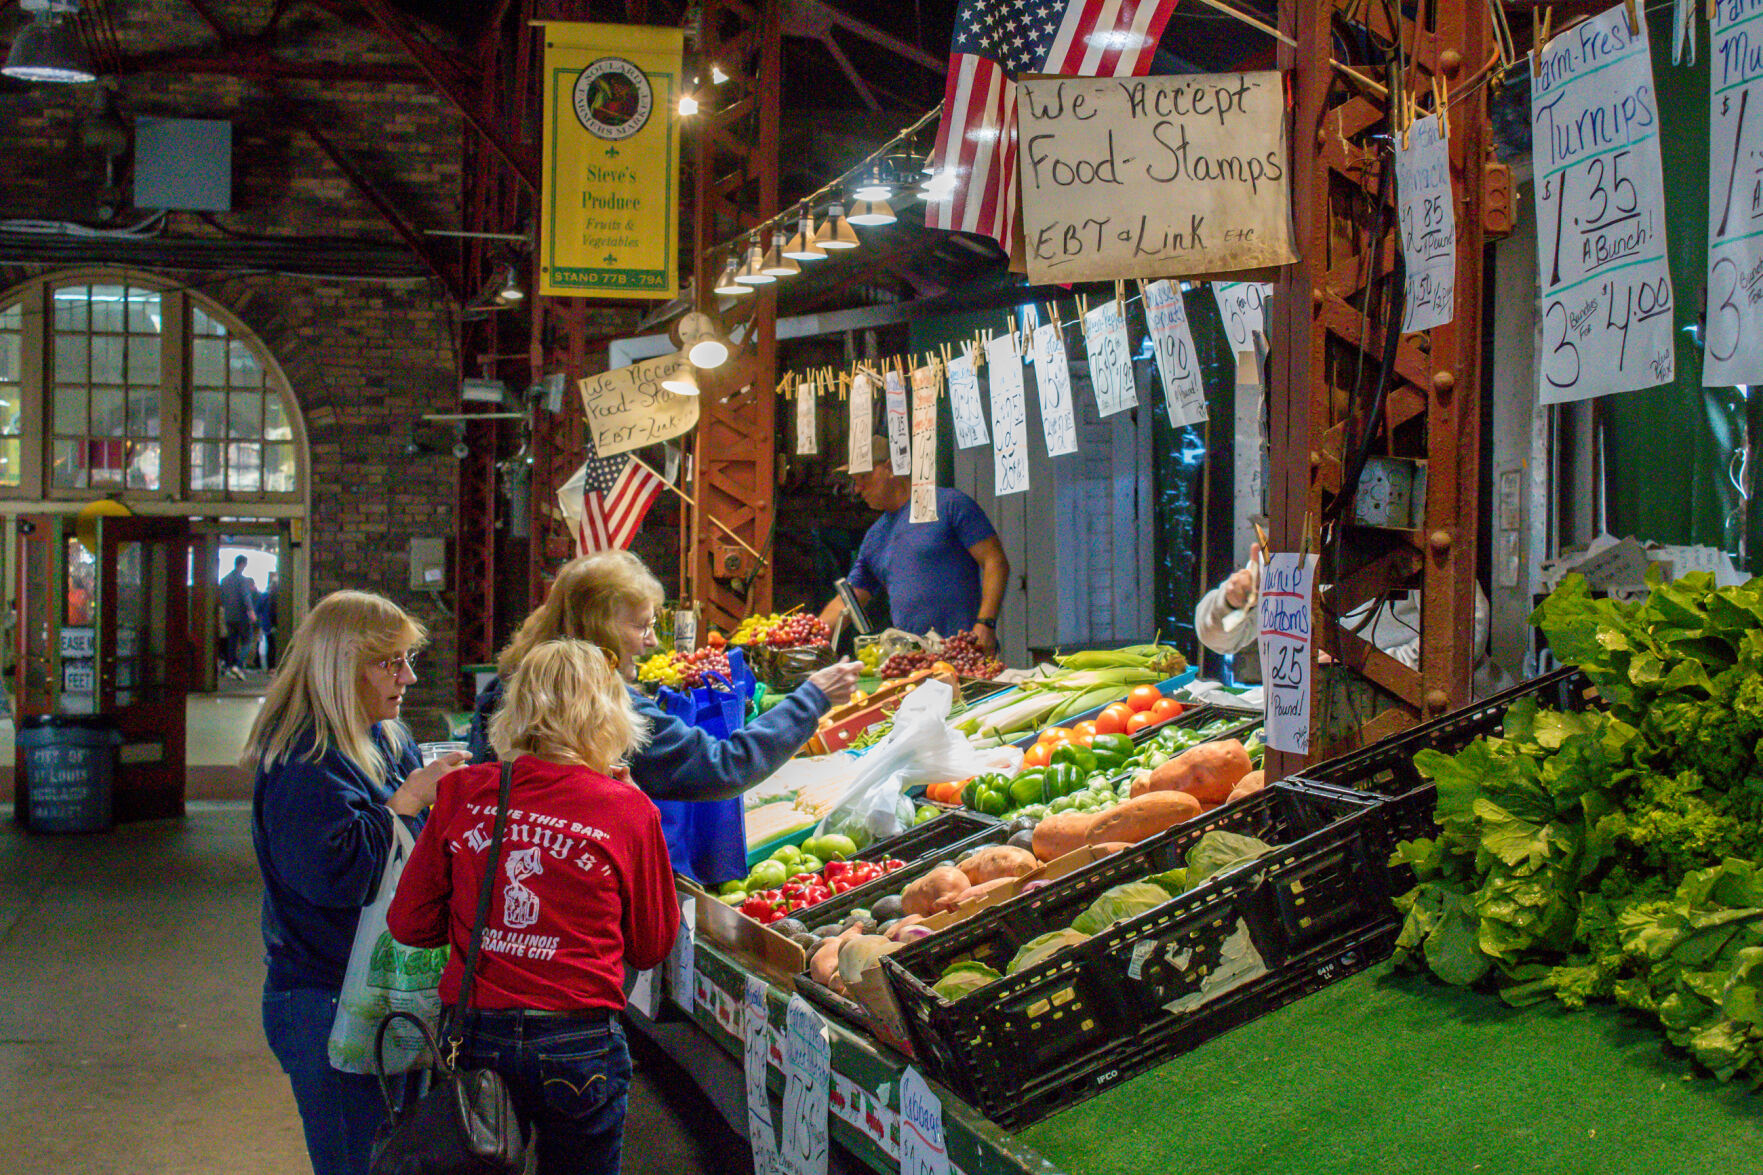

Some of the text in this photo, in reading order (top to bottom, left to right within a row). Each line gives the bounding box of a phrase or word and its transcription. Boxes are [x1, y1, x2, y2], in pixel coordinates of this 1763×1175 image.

[1536, 86, 1653, 165] Turnips
[1146, 120, 1283, 195] Stamps
[586, 165, 637, 183] Steve's
[582, 191, 641, 211] Produce
[585, 218, 635, 231] Fruits &
[582, 234, 639, 250] Vegetables
[1033, 217, 1112, 260] EBT
[555, 271, 598, 283] STAND
[602, 273, 627, 285] 77B
[640, 275, 664, 285] 79A
[1710, 256, 1740, 362] 3
[1546, 301, 1580, 388] 3
[584, 375, 617, 397] We
[1261, 598, 1308, 635] Bottoms
[67, 673, 92, 688] FEET
[528, 812, 568, 829] THIS
[481, 937, 557, 961] RANITE CITY
[507, 931, 561, 949] ILLINOIS
[1096, 1069, 1119, 1085] IFCO
